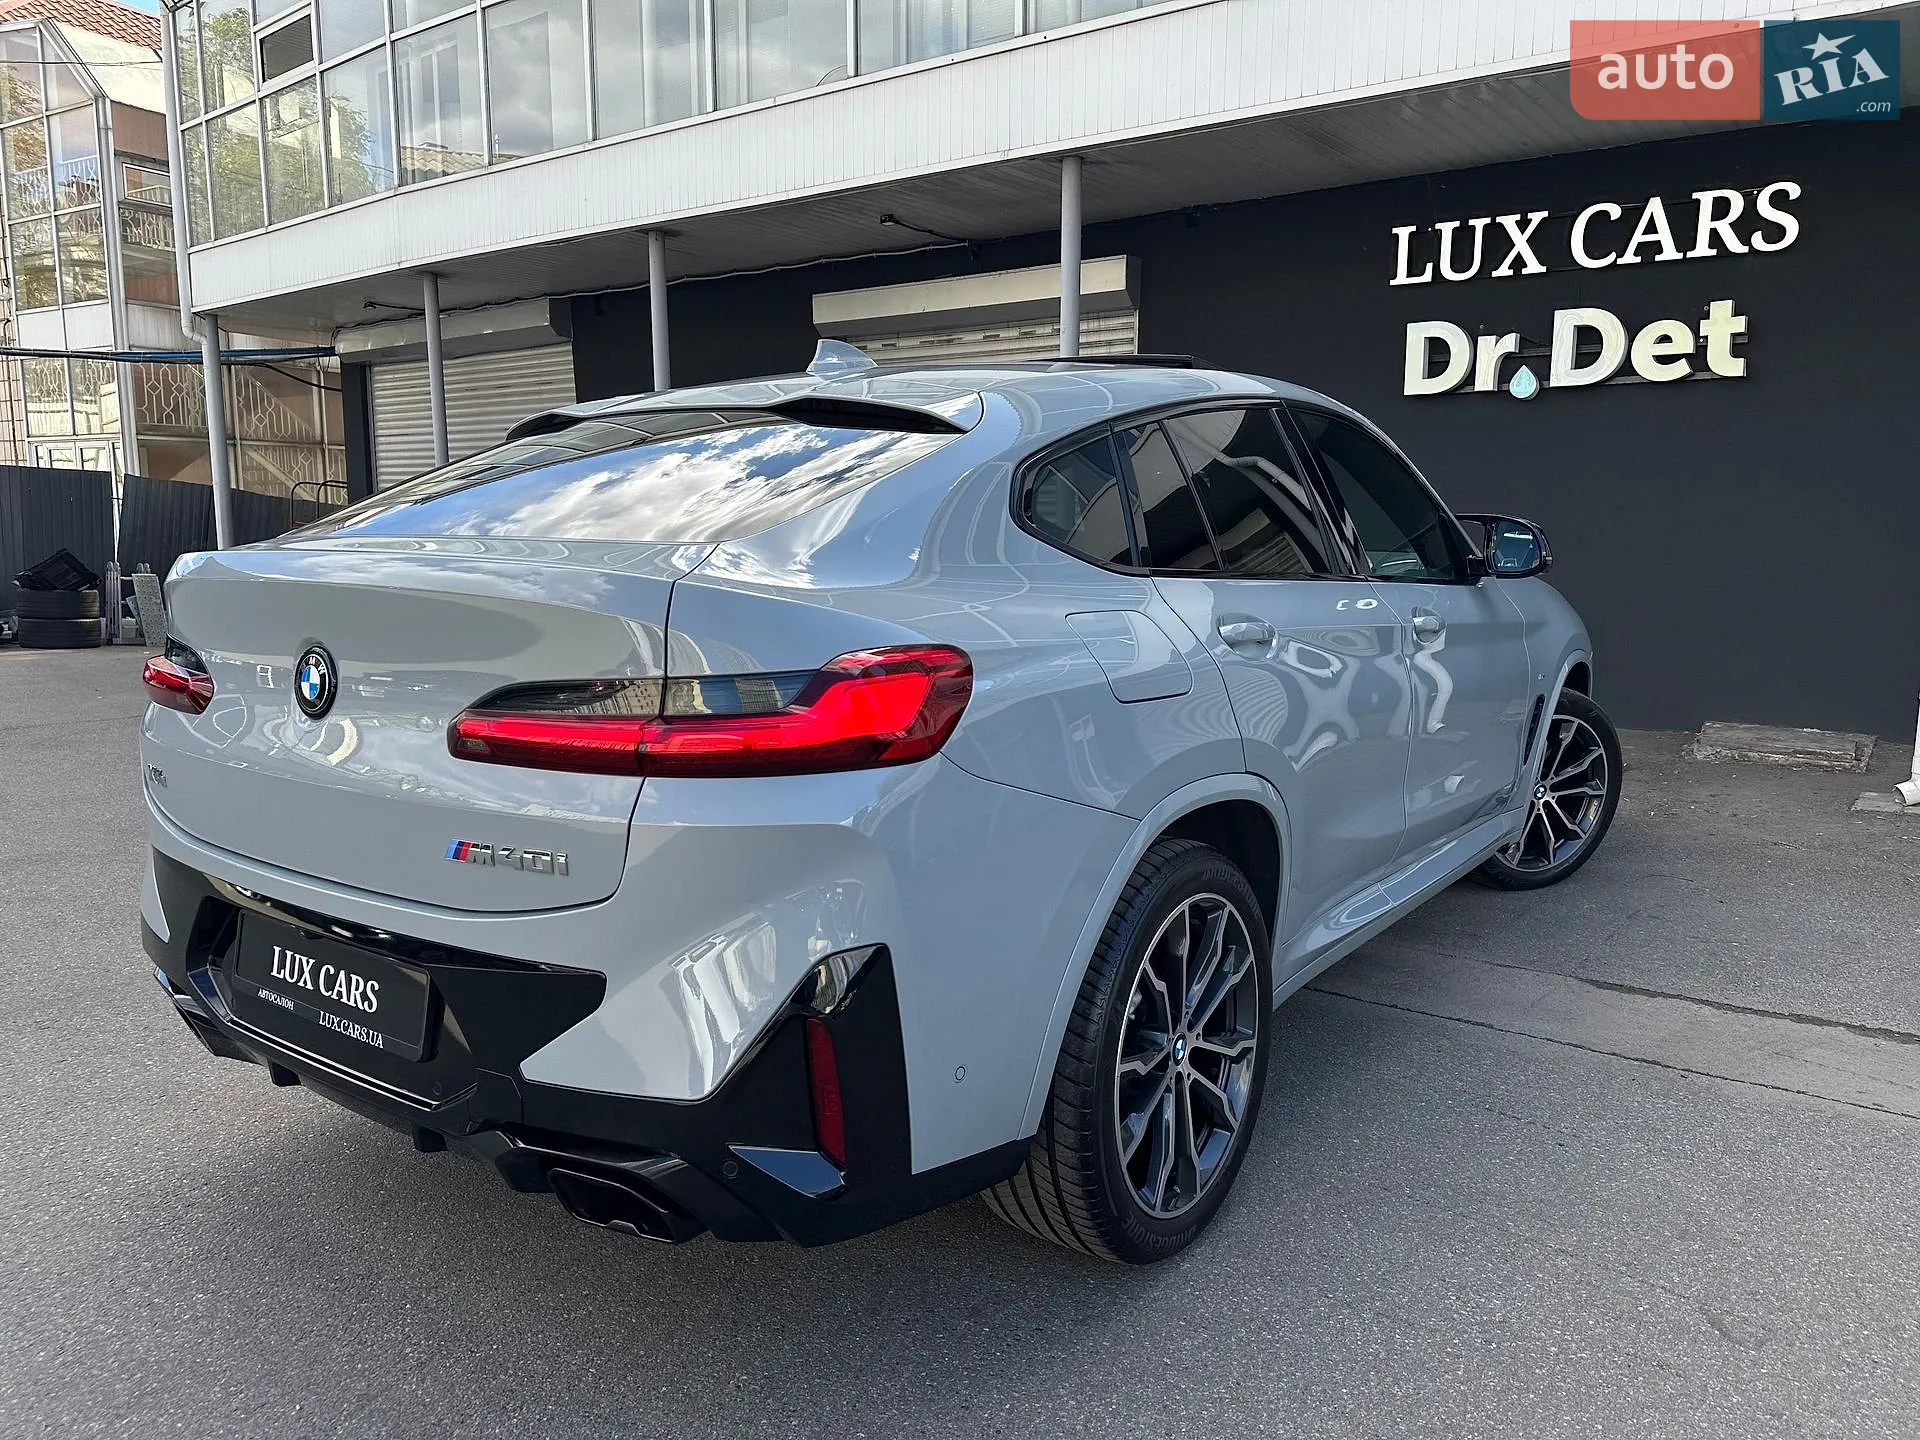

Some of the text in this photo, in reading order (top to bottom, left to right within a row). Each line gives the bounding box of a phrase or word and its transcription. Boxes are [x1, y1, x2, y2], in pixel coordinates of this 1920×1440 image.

[1389, 181, 1802, 286] LUX CARS
[270, 945, 380, 1013] LUX CARS
